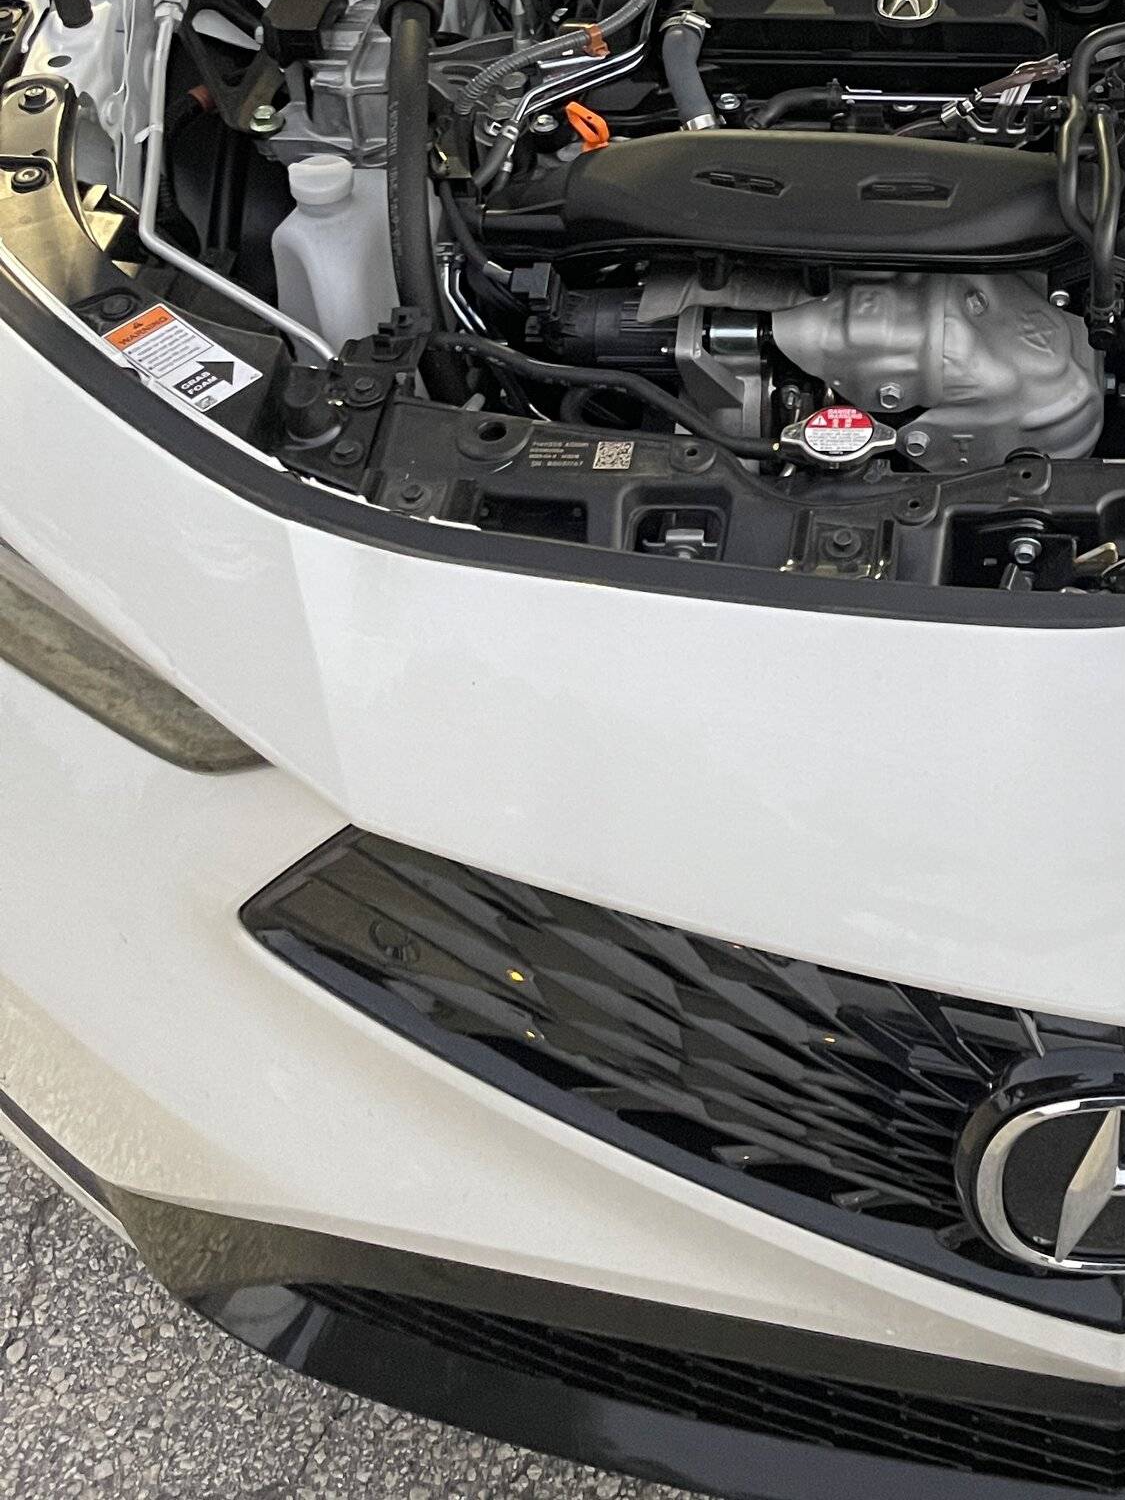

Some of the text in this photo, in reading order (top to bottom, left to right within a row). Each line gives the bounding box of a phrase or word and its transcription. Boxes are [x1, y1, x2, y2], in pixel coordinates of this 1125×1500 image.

[117, 316, 168, 346] WARNING
[181, 371, 212, 391] GRAB
[188, 375, 219, 396] FOAM
